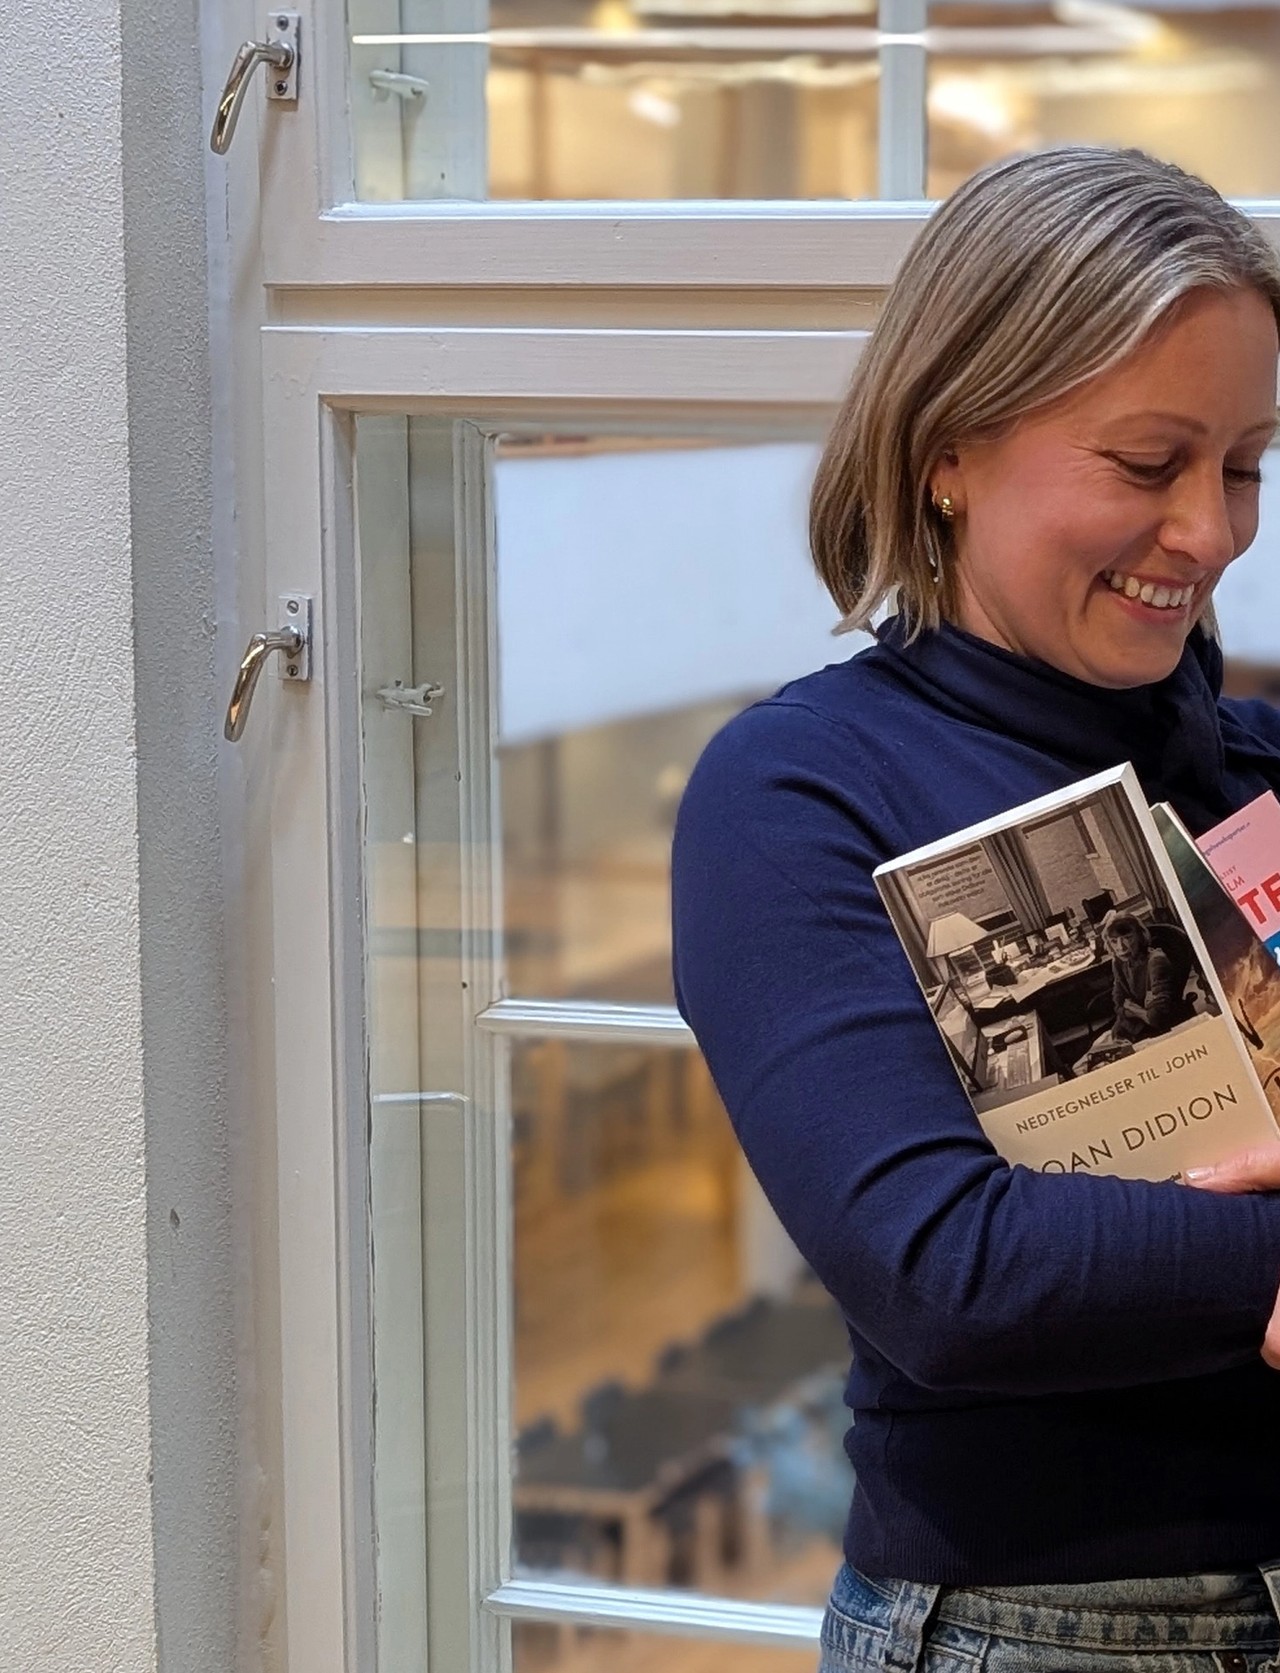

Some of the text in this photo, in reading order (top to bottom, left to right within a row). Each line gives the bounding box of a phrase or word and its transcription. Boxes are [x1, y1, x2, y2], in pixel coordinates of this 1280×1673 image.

[1015, 1044, 1210, 1135] NEDTEGNELSER TIL JOHN
[1034, 1083, 1238, 1175] OAN DIDION
